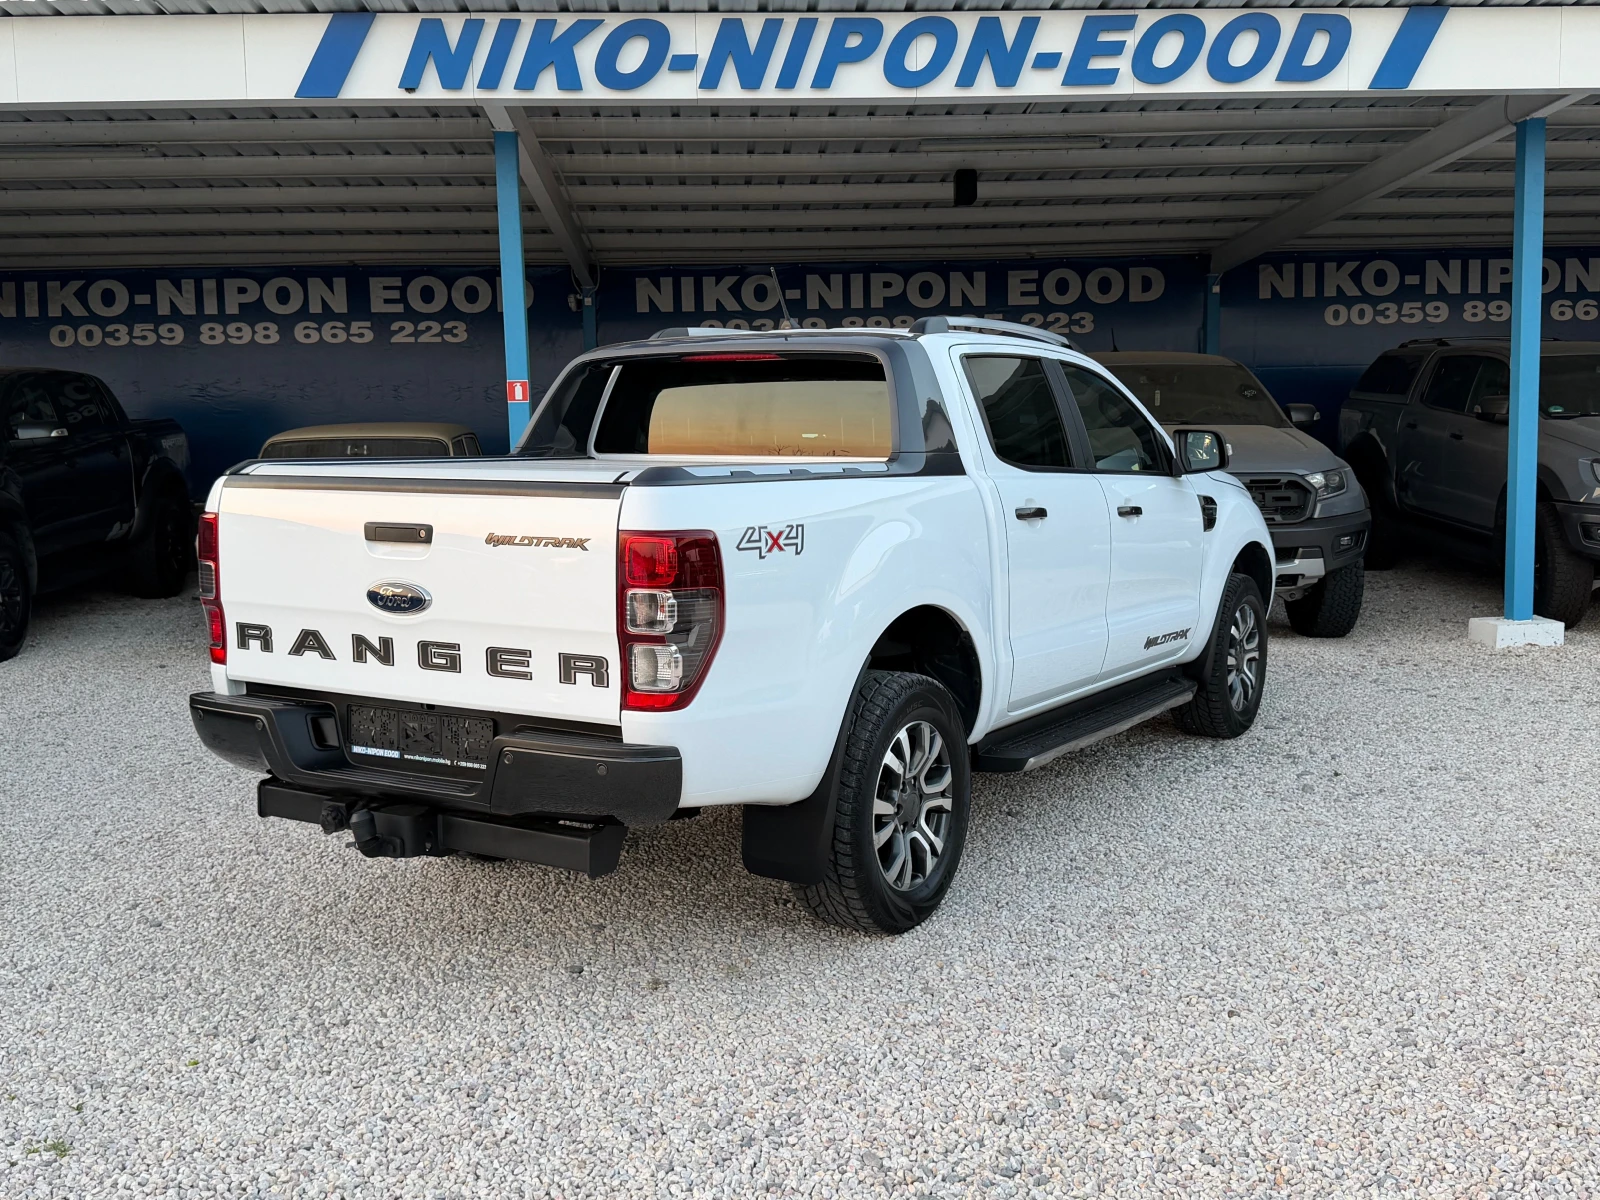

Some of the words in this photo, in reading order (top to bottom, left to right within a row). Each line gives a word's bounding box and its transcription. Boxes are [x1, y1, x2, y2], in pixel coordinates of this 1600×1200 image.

[398, 13, 1352, 91] NIKO-NIPON-EOOD
[635, 271, 986, 313] NIKO-NIPON
[1007, 267, 1165, 306] EOOD
[1020, 311, 1095, 334] 223
[1324, 301, 1449, 326] 00359
[1462, 300, 1511, 323] 89
[49, 323, 184, 347] 00359
[200, 322, 280, 345] 898
[294, 320, 374, 344] 665
[390, 319, 468, 343] 223
[485, 532, 591, 551] WILDTRAK
[377, 586, 411, 608] Ford
[1143, 627, 1191, 651] WILDTRAK
[236, 622, 609, 688] RANGER
